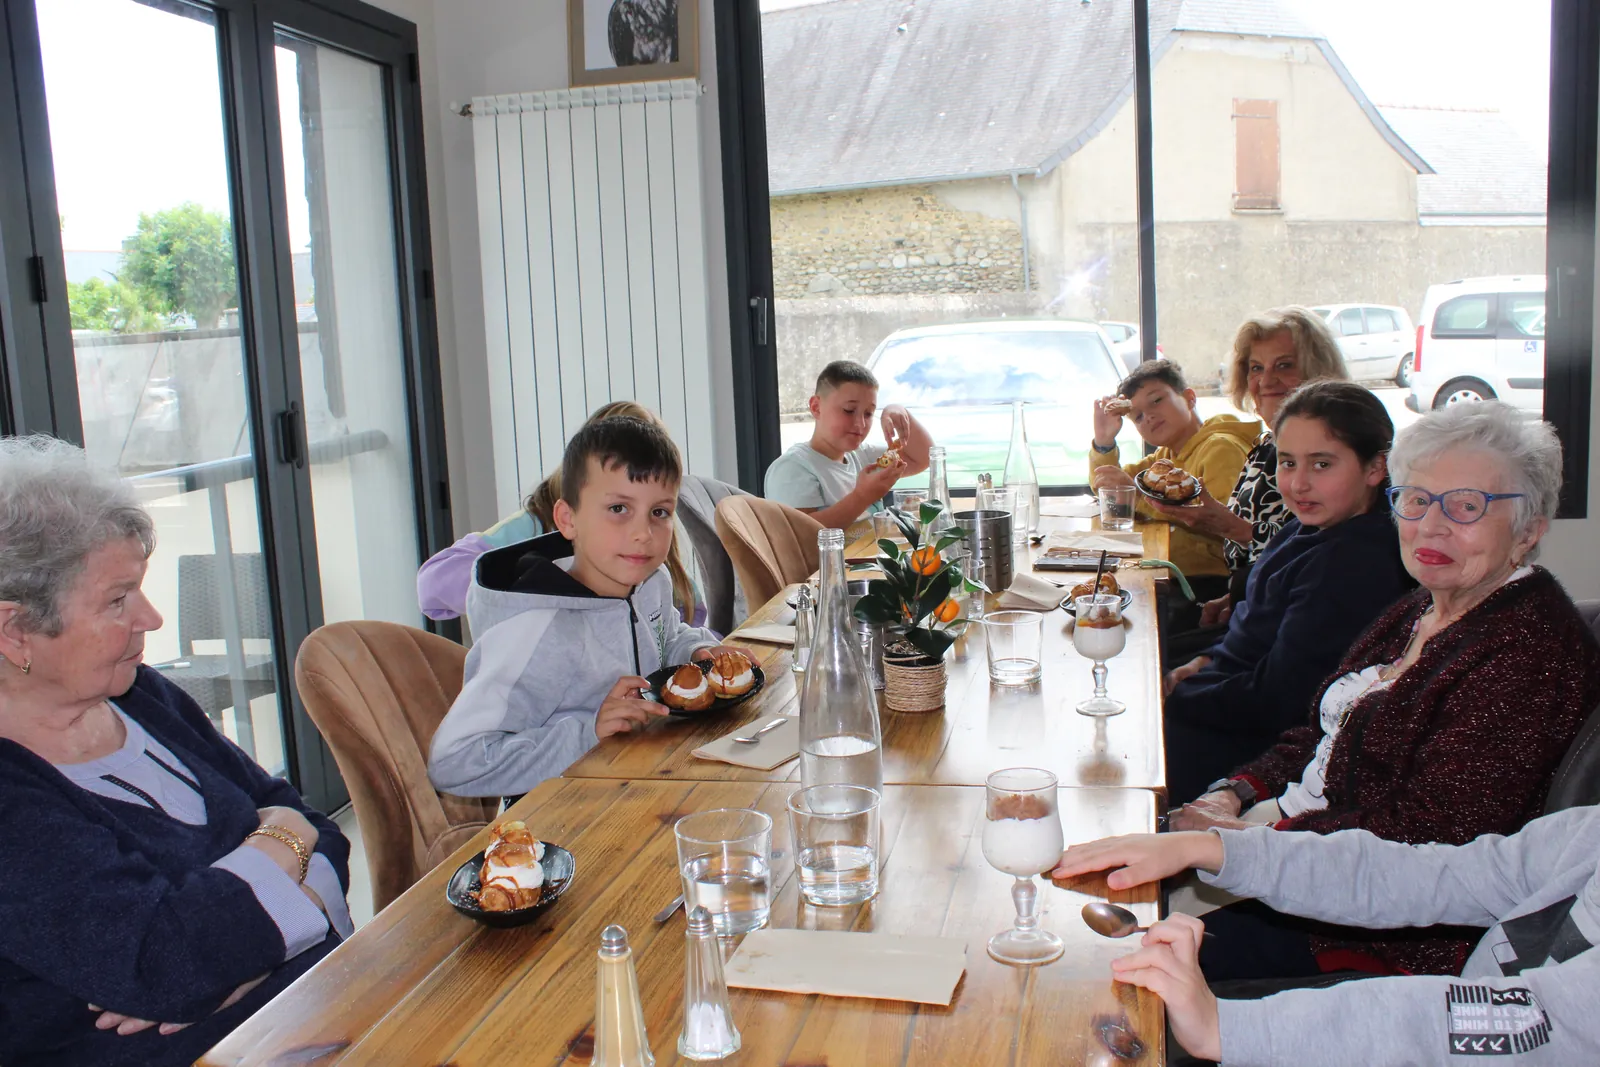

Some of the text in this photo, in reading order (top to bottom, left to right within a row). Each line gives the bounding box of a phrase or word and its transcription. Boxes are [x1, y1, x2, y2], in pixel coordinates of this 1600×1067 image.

[1453, 1005, 1488, 1016] MINE
[1492, 1006, 1511, 1017] TO
[1454, 1018, 1489, 1030] MINE
[1494, 1019, 1513, 1030] TO
